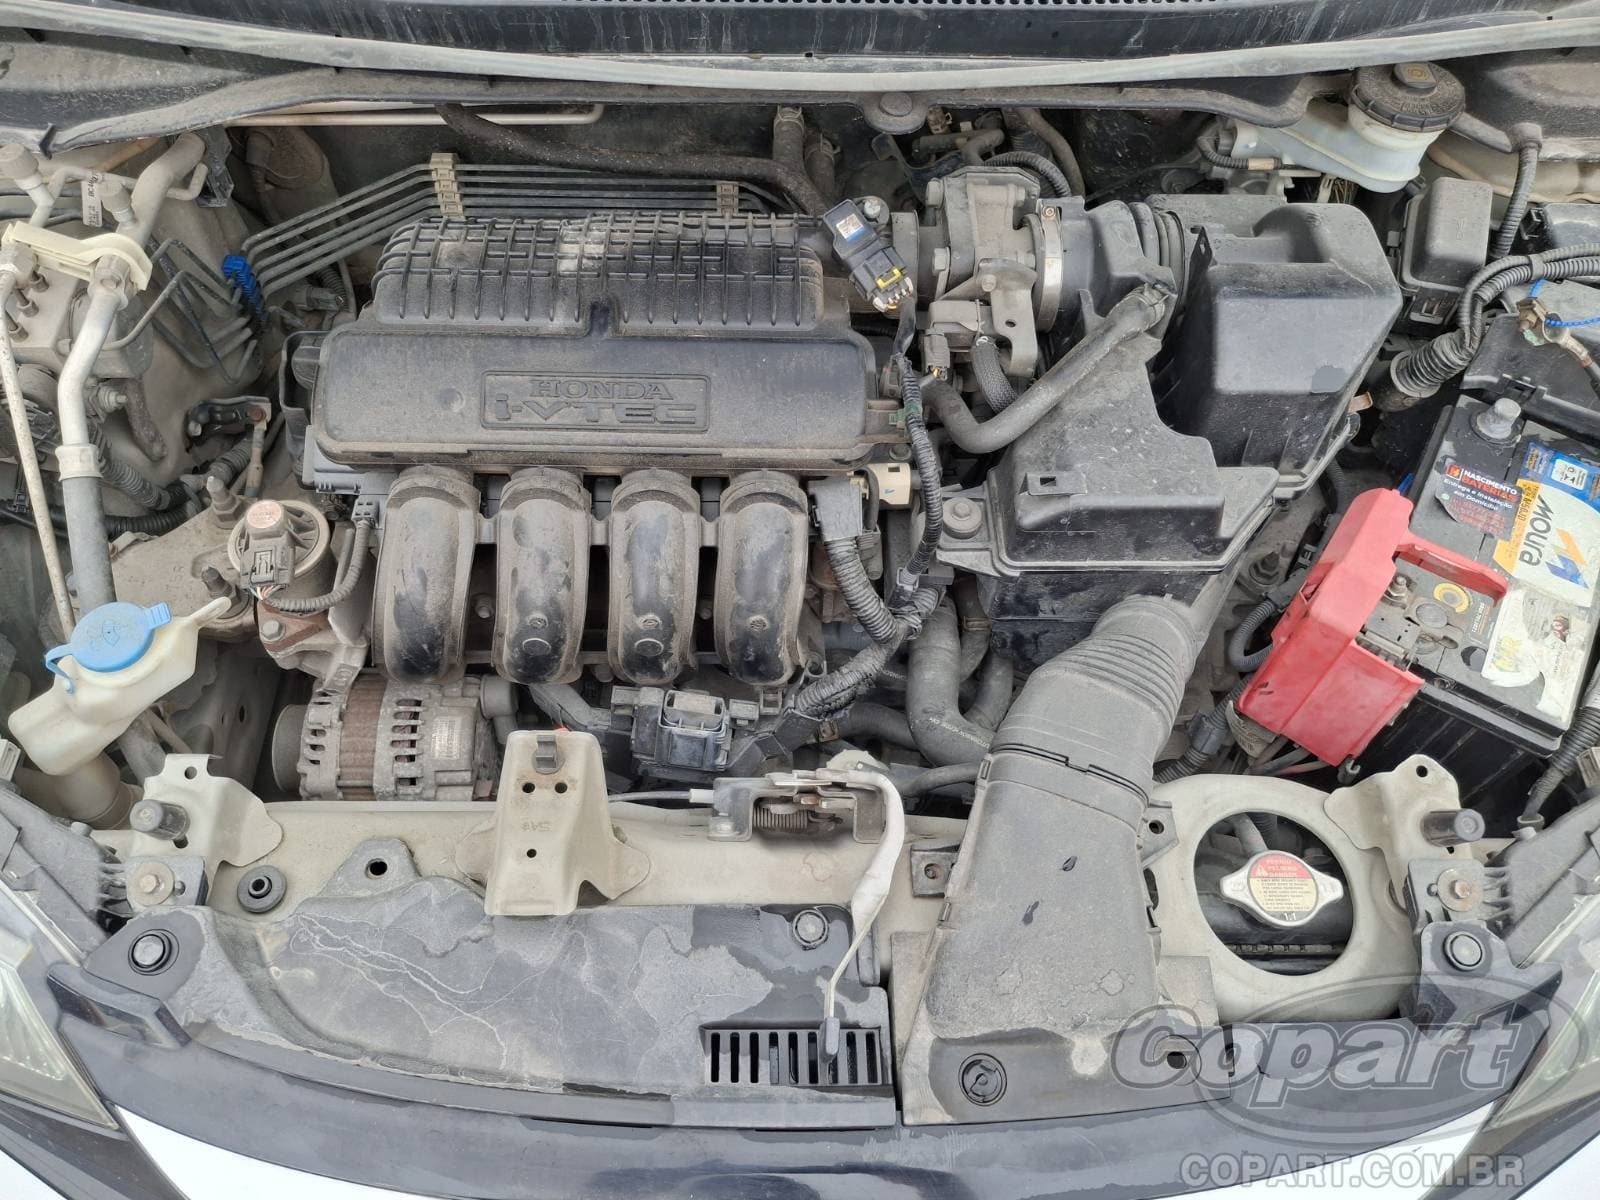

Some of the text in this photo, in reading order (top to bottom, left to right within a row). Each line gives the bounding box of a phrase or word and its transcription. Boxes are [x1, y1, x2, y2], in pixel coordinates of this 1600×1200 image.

[530, 379, 674, 400] HONDA
[495, 394, 697, 424] i-VTEC
[1461, 475, 1517, 503] BATERIAS
[1463, 470, 1517, 495] NASCIMENTO
